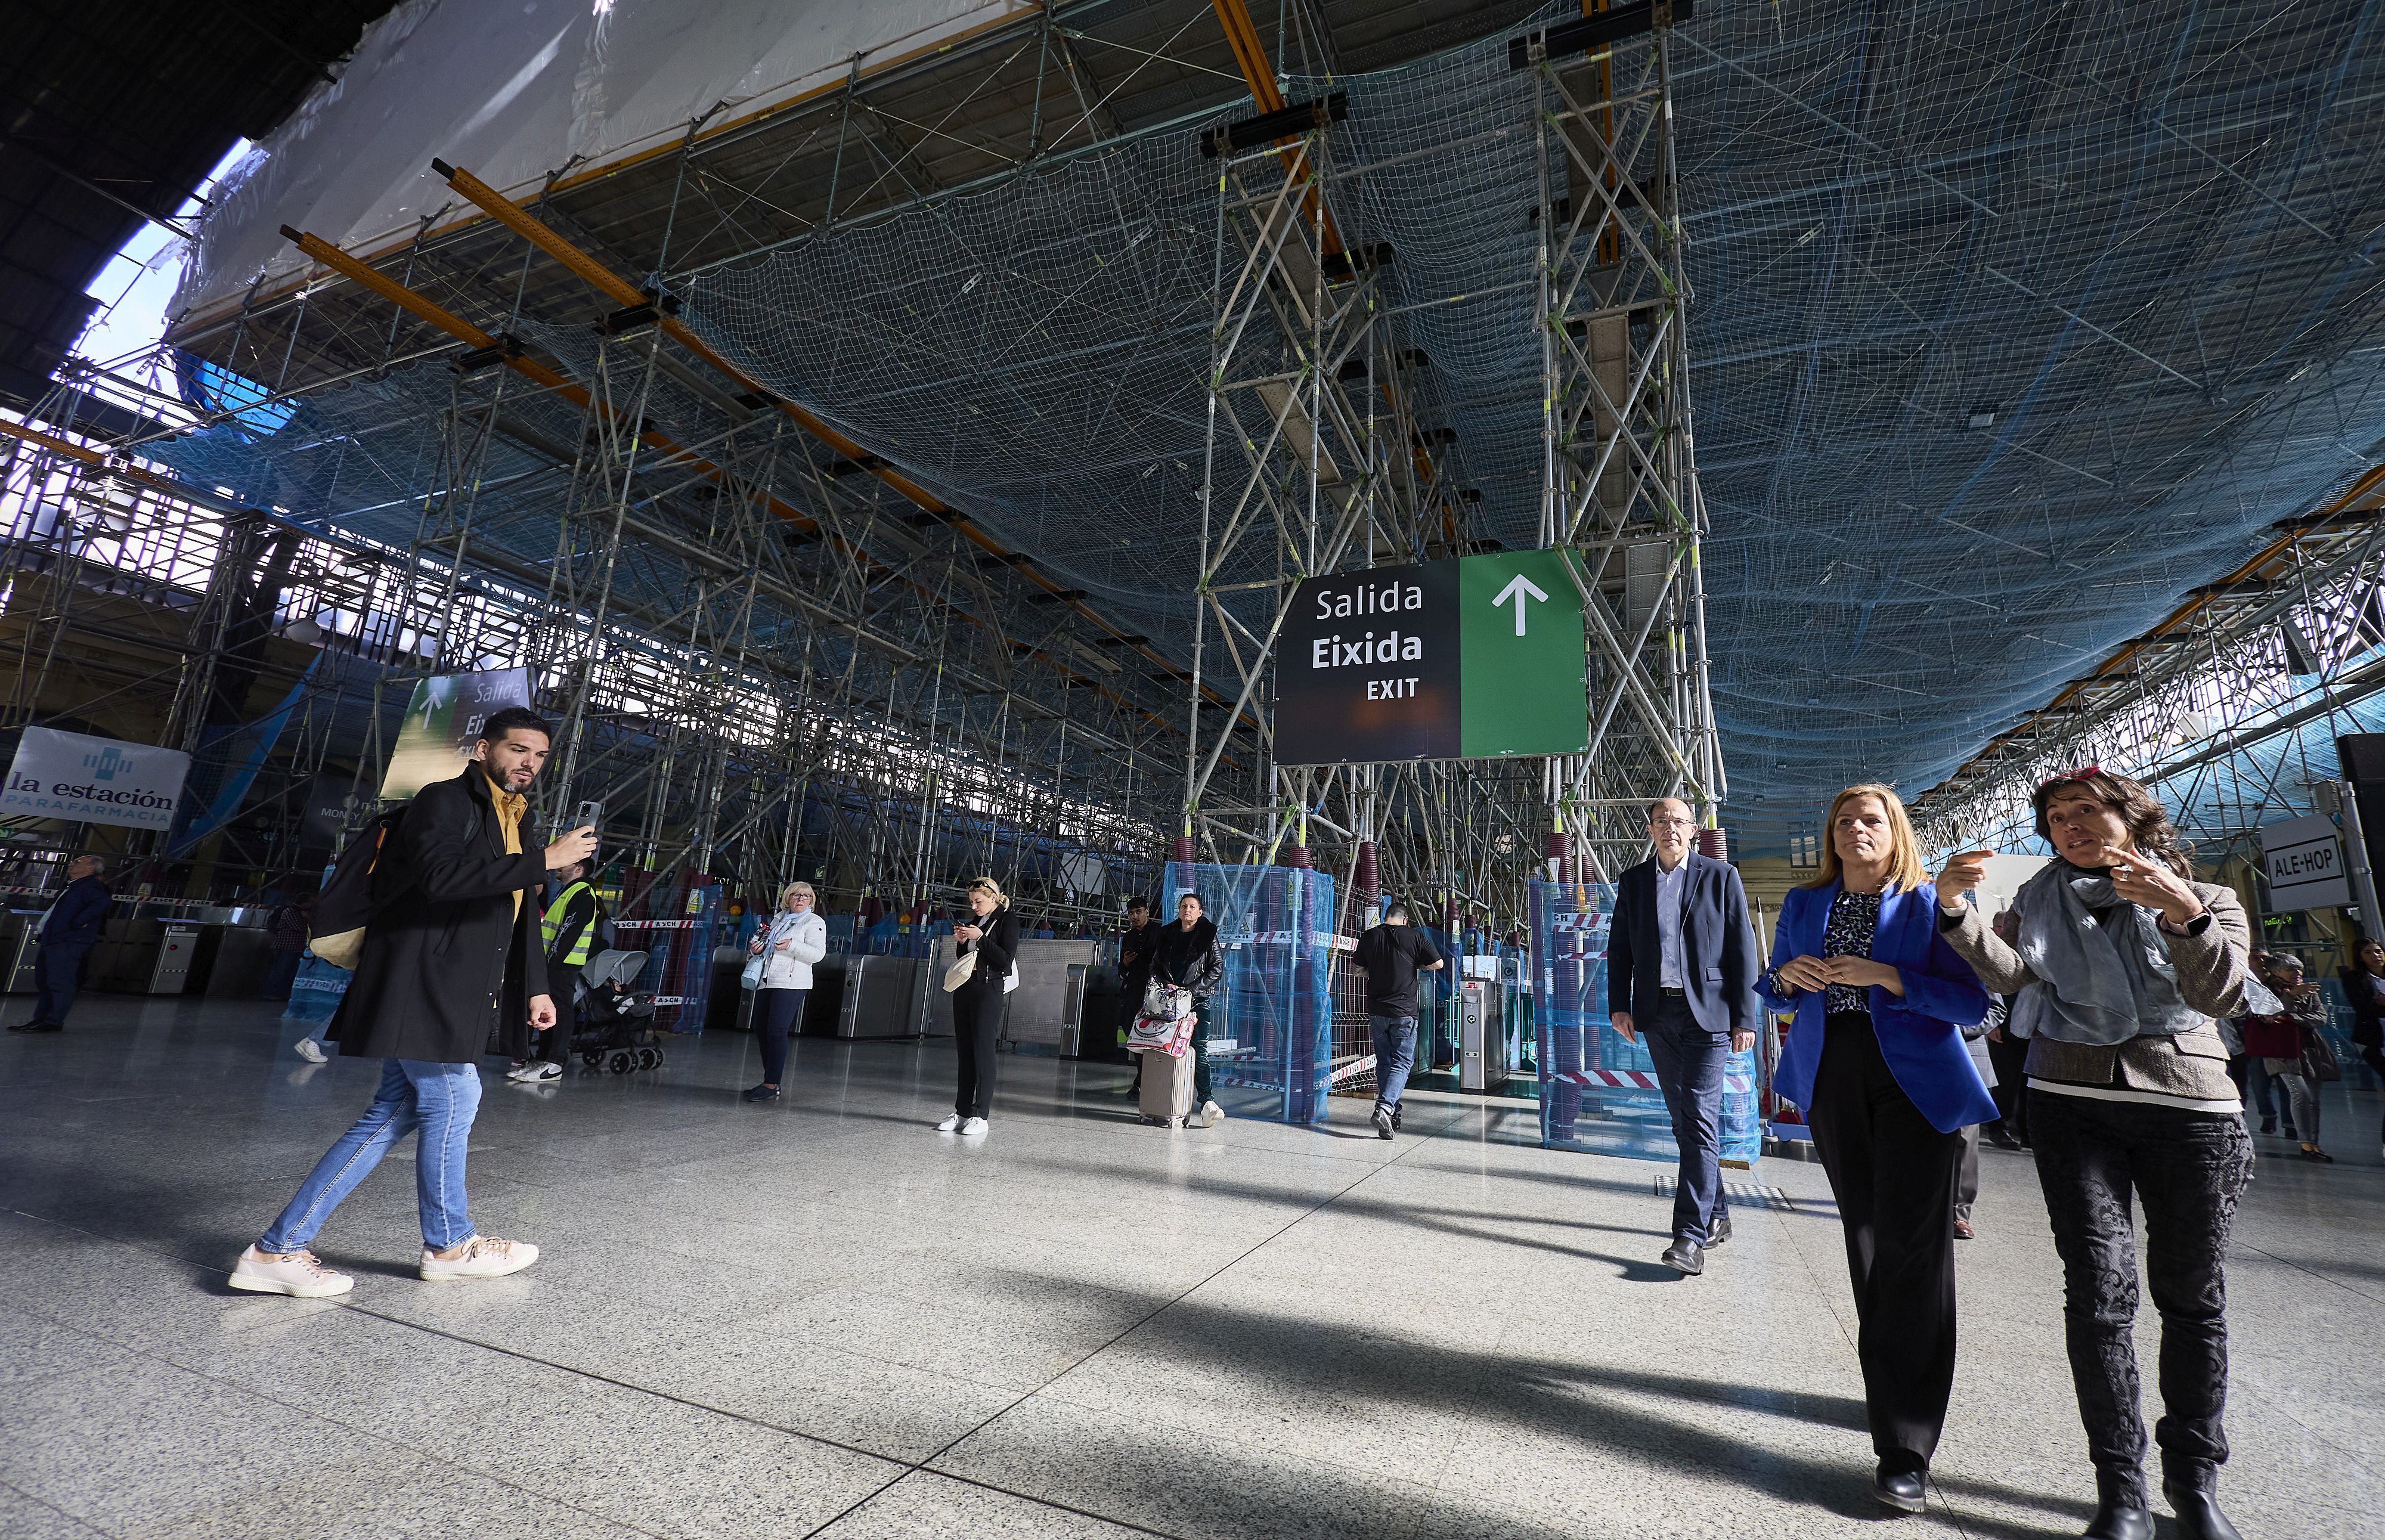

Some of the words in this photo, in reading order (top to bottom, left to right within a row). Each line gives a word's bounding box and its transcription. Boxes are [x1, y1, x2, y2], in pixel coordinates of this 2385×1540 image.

[1317, 581, 1422, 619] Salida
[1312, 631, 1421, 668] Eixida
[474, 680, 522, 703] Salida
[1367, 677, 1419, 701] EXIT
[458, 745, 476, 758] EXI
[8, 771, 40, 792] la
[52, 783, 172, 810] estación
[5, 795, 168, 823] PARAFARMACIA
[321, 808, 360, 820] MONY
[2275, 848, 2332, 878] ALE-HOP
